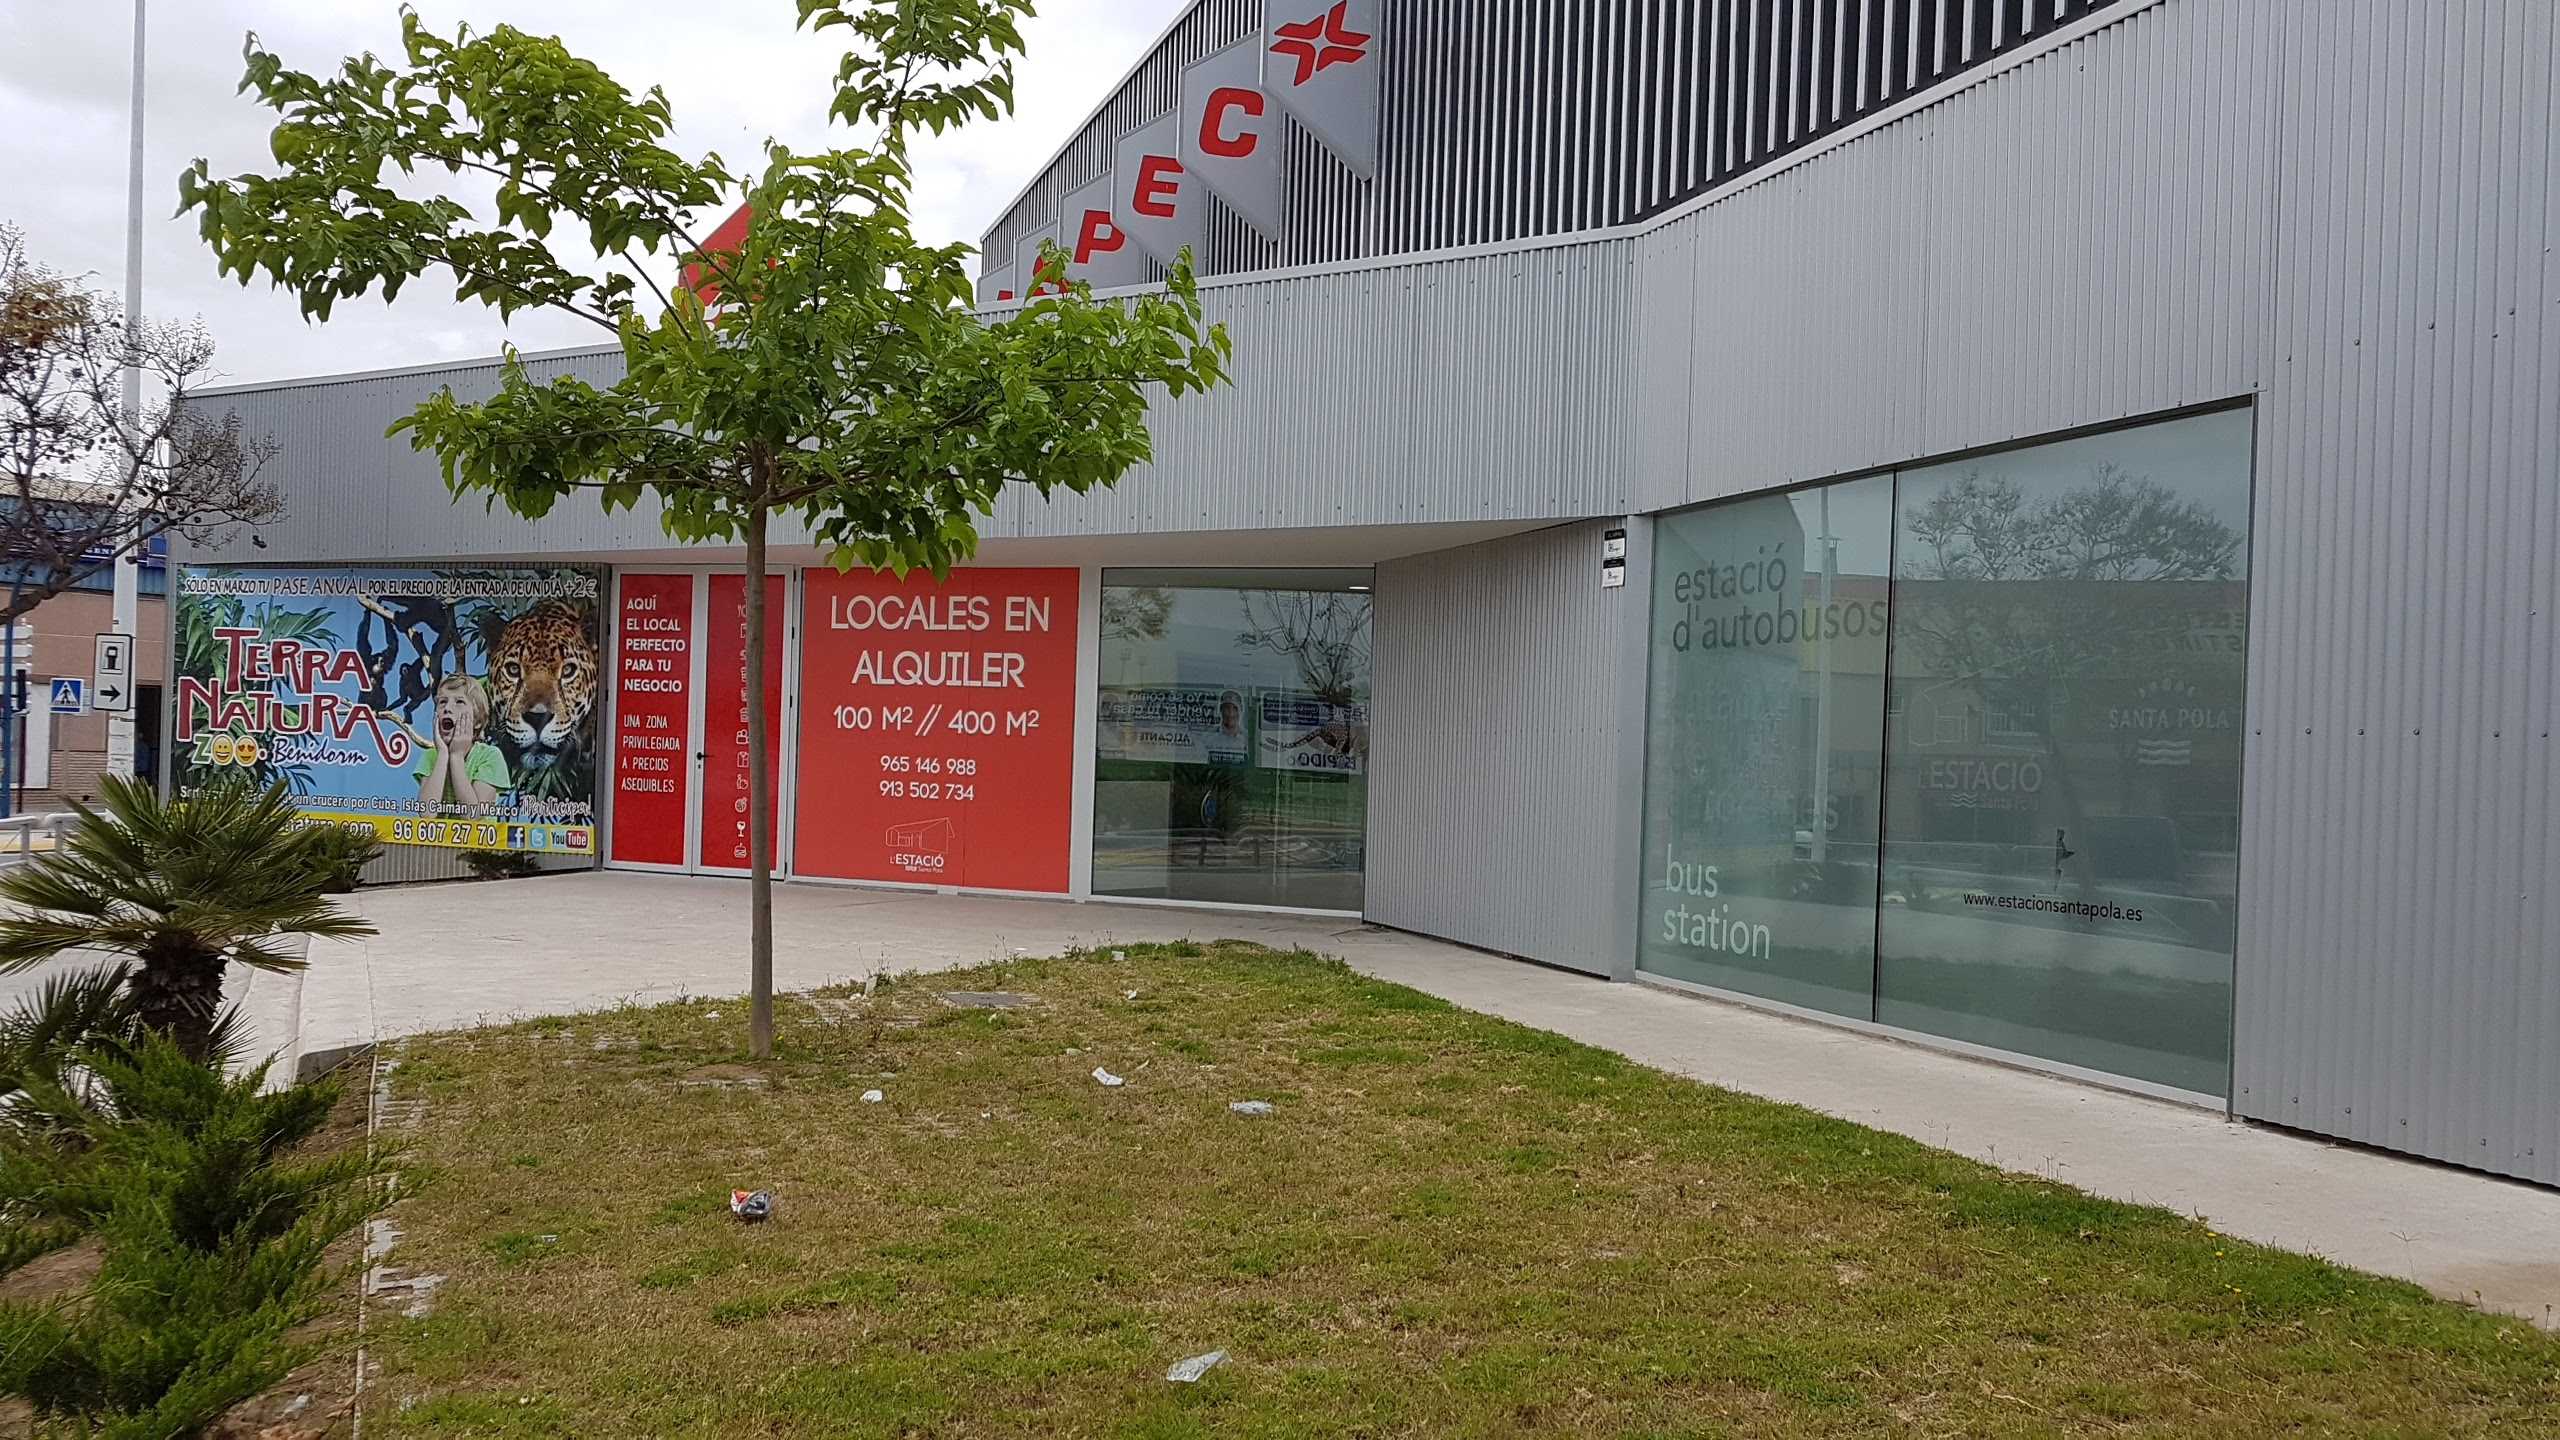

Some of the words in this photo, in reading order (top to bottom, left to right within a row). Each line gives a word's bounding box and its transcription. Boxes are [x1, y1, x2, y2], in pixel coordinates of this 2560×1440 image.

[1674, 542, 1787, 602] estació
[210, 579, 221, 593] EN
[224, 579, 256, 593] MARZO
[257, 580, 270, 594] TU
[273, 577, 307, 595] PASE
[311, 577, 366, 595] ANUAL
[369, 580, 387, 594] POR
[389, 580, 399, 594] EL
[401, 580, 433, 595] PRECIO
[436, 580, 448, 595] DE
[450, 580, 462, 595] LA
[465, 580, 509, 596] ENTRADA
[512, 581, 523, 595] DE
[525, 581, 541, 596] UN
[626, 594, 657, 611] AQUÍ
[831, 595, 990, 631] LOCALES
[1004, 596, 1050, 632] EN
[626, 618, 640, 631] EL
[643, 618, 681, 632] LOCAL
[1672, 592, 1888, 652] d'autobusos
[625, 639, 686, 652] PERFECTO
[212, 627, 372, 695] TERRA
[625, 659, 654, 672] PARA
[657, 659, 672, 672] TU
[851, 650, 1025, 688] ALQUILER
[624, 679, 682, 693] NEGOCIO
[177, 677, 409, 767] NATURA
[623, 714, 640, 728] UNA
[646, 715, 668, 729] ZONA
[833, 705, 872, 730] 100
[948, 709, 996, 736] 400
[2109, 704, 2169, 729] SANTA
[2177, 705, 2231, 729] POLA
[272, 735, 368, 765] Benidorm
[622, 735, 680, 751] PRIVILEGIADA
[622, 756, 628, 769] A
[632, 757, 669, 772] PRECIOS
[880, 755, 910, 772] 965
[915, 757, 940, 774] 146
[946, 758, 976, 775] 988
[621, 777, 675, 793] ASEQUIBLES
[880, 780, 904, 797] 913
[909, 782, 939, 799] 502
[945, 784, 974, 801] 734
[312, 796, 349, 808] crucero
[351, 799, 368, 811] por
[402, 798, 426, 812] Islas
[469, 804, 477, 817] y
[393, 821, 412, 840] 96
[417, 822, 446, 842] 607
[452, 824, 471, 844] 27
[477, 825, 497, 846] 70
[1666, 843, 1718, 898] bus
[1963, 894, 2143, 922] www.estacionsantapola.es
[1663, 903, 1770, 960] station
